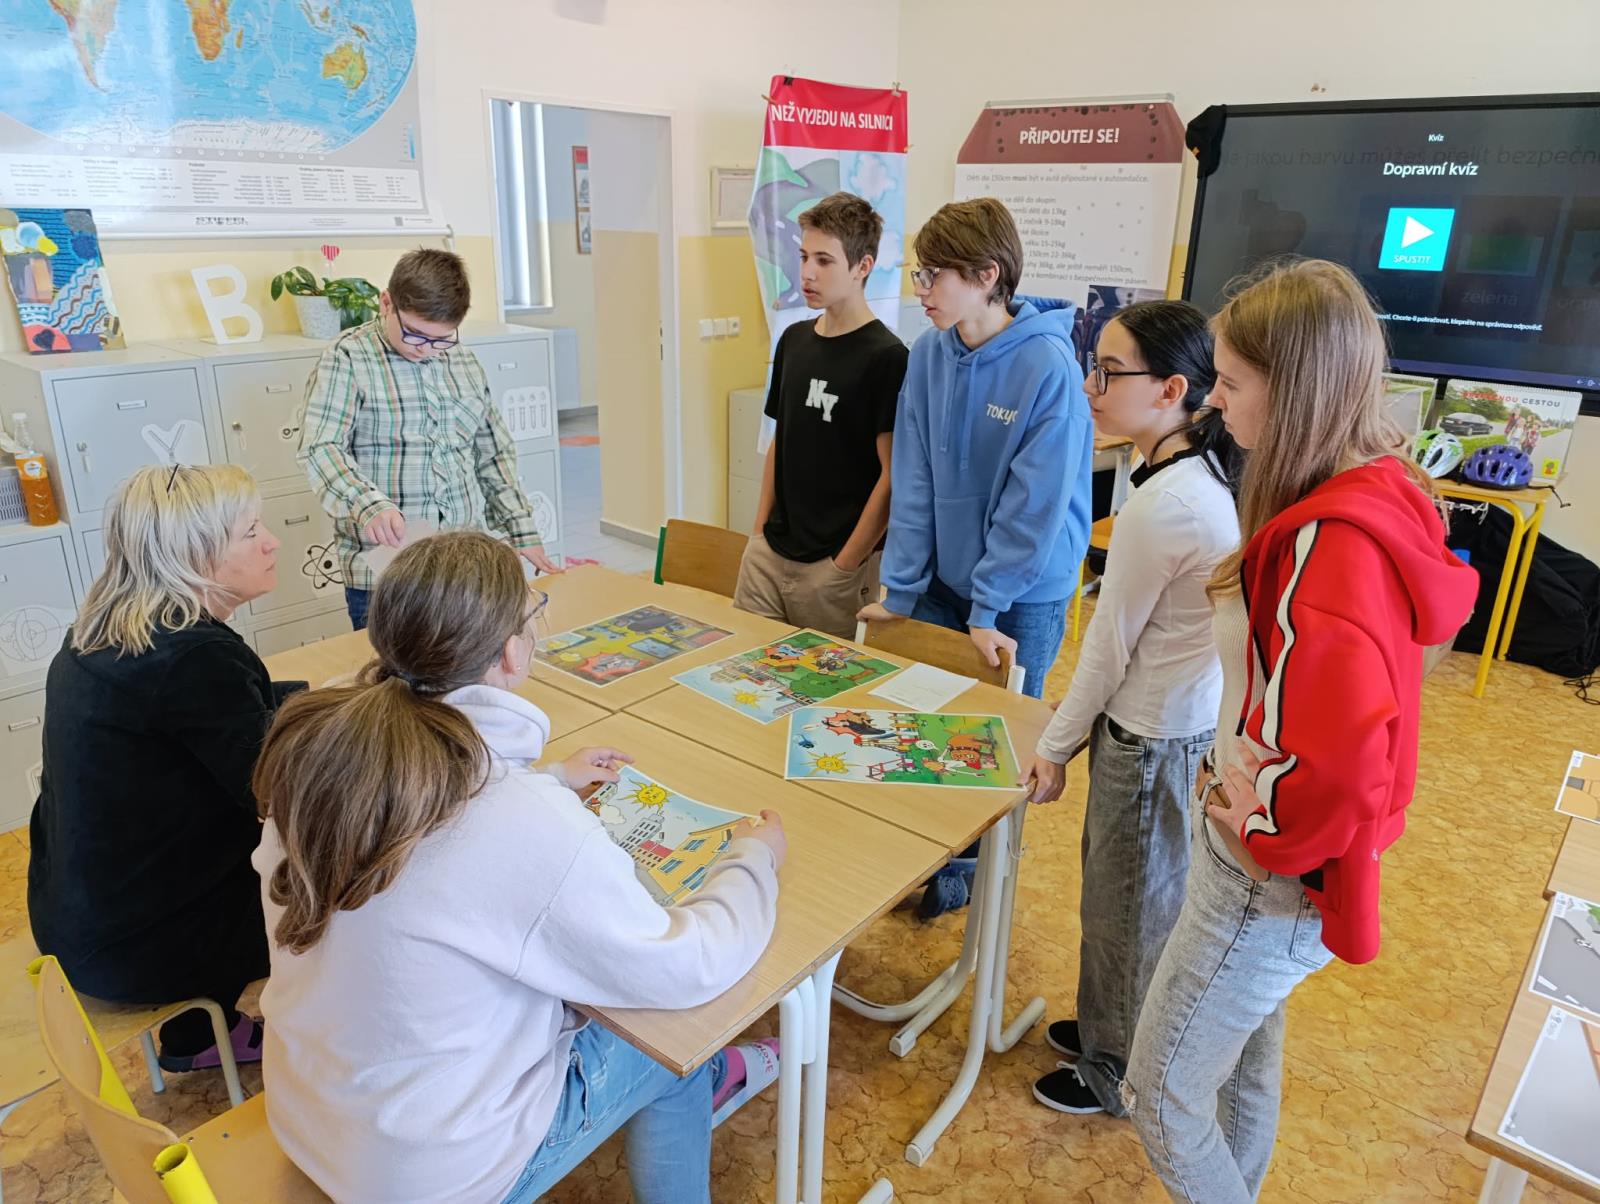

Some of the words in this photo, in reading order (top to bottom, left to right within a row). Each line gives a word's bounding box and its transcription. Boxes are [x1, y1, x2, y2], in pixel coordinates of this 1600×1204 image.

[771, 101, 795, 122] NEŽ
[797, 107, 838, 127] VYJEDU
[840, 111, 856, 128] NA
[858, 113, 893, 131] SILNICI
[1019, 127, 1093, 145] PŘIPOUTEJ
[1096, 127, 1120, 143] SE!
[1428, 133, 1444, 142] Kvíz
[1383, 161, 1448, 178] Dopravní
[1449, 161, 1479, 176] kvíz
[1393, 255, 1432, 264] SPUSTIT
[1522, 398, 1560, 408] CESTOU
